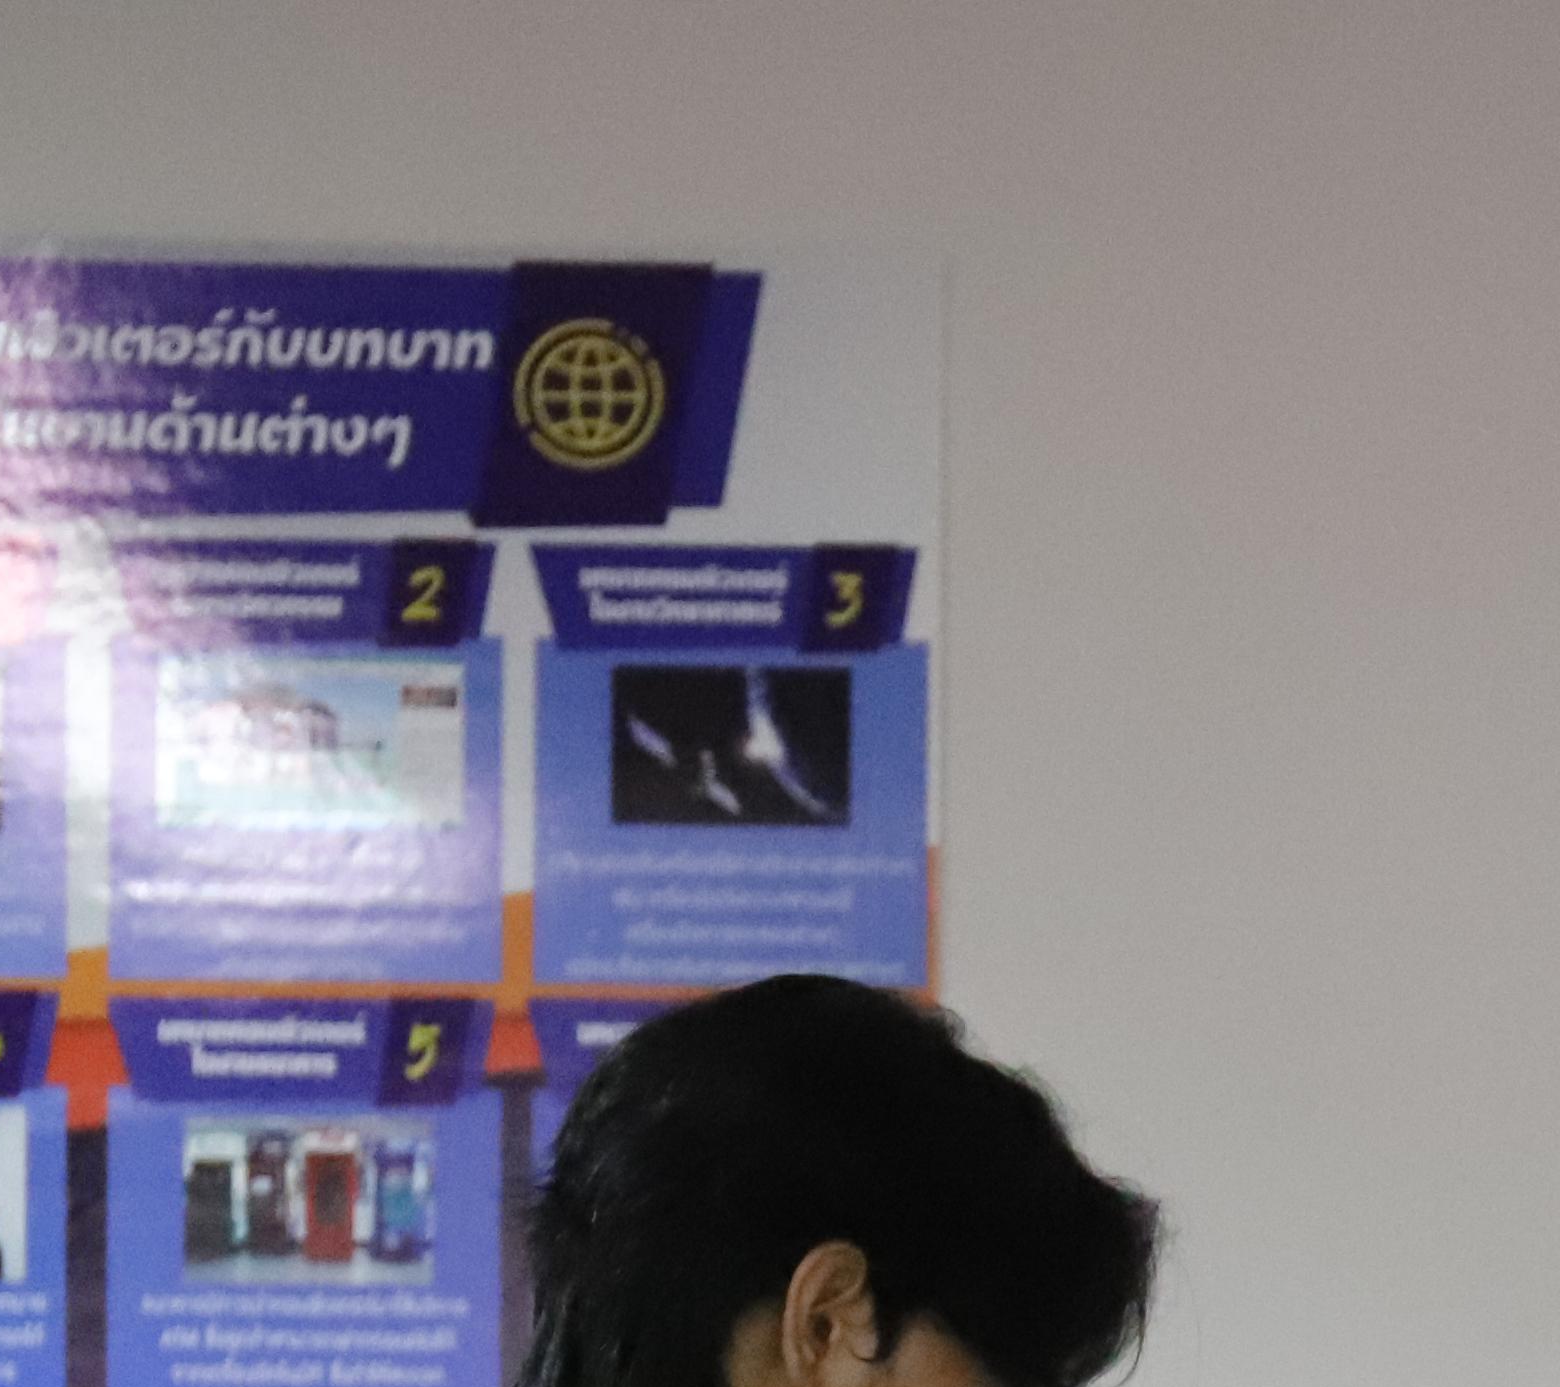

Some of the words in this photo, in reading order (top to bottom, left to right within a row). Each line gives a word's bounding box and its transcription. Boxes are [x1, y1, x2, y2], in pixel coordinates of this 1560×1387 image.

[400, 565, 446, 622] 2
[824, 571, 864, 629] 3
[403, 1023, 442, 1081] 5
